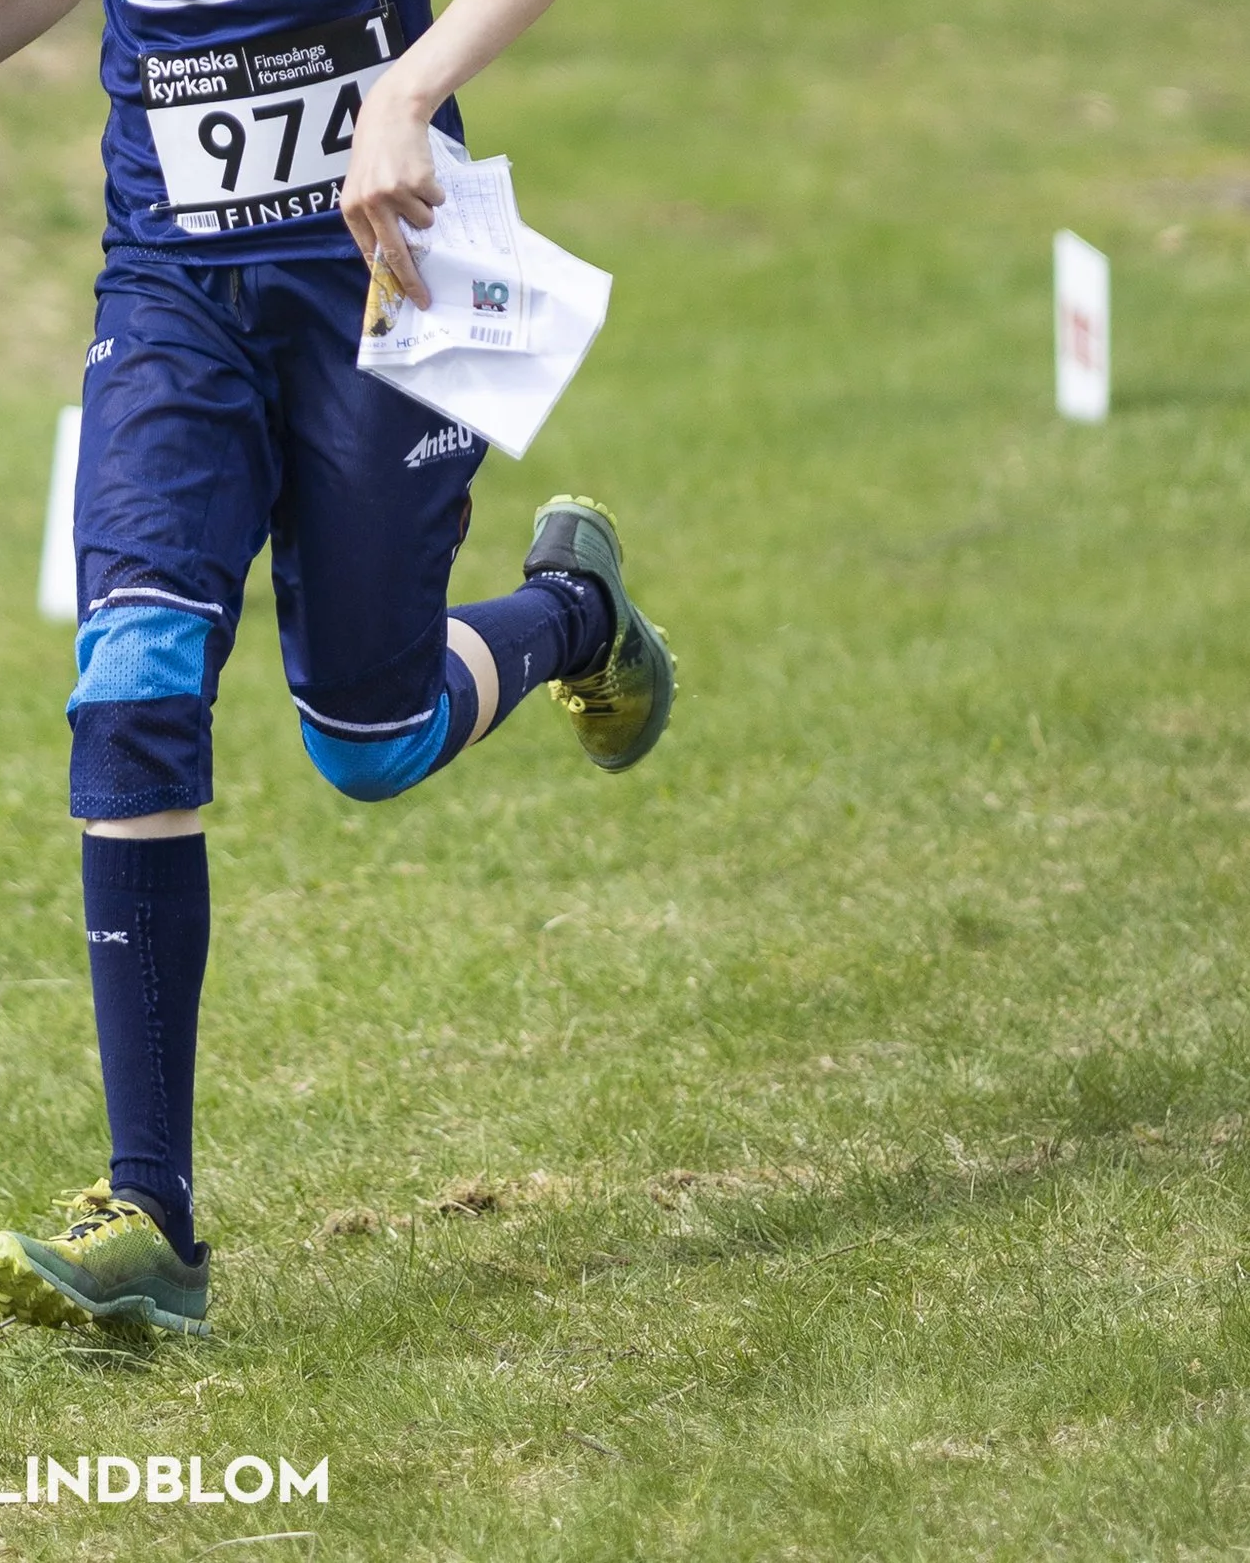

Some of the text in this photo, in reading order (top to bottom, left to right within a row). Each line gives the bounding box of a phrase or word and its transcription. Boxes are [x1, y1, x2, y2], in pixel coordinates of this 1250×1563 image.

[365, 16, 392, 59] 1
[146, 50, 239, 78] Svenska
[253, 42, 327, 71] Finspångs
[257, 56, 335, 86] församling
[148, 73, 228, 103] kyrkan
[197, 80, 363, 193] 974
